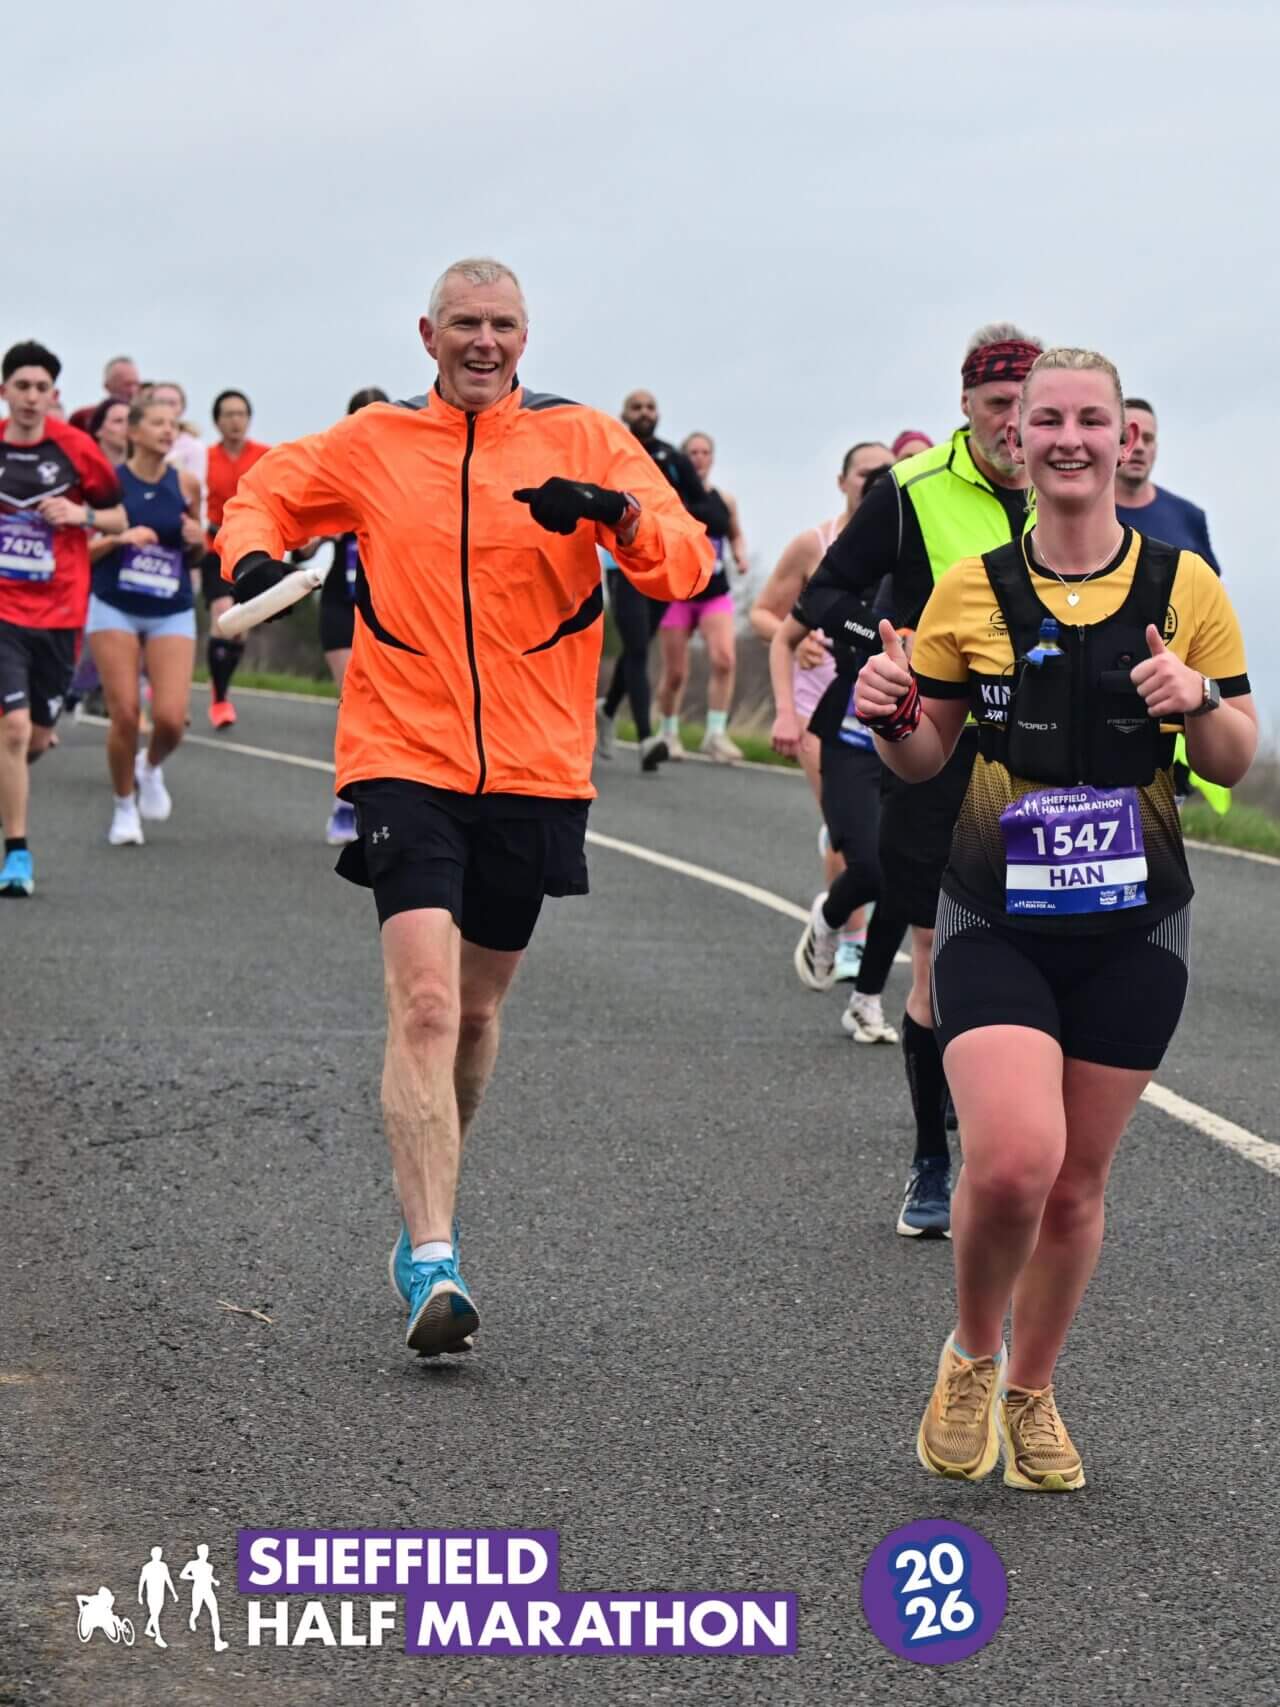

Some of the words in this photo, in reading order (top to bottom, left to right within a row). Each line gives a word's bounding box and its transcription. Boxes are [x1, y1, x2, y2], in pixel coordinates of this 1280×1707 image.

[1041, 793, 1087, 805] SHEFFIELD
[1042, 804, 1065, 815] HALF
[1068, 798, 1123, 813] MARATHON
[1032, 820, 1120, 857] 1547
[1050, 864, 1105, 888] HAN
